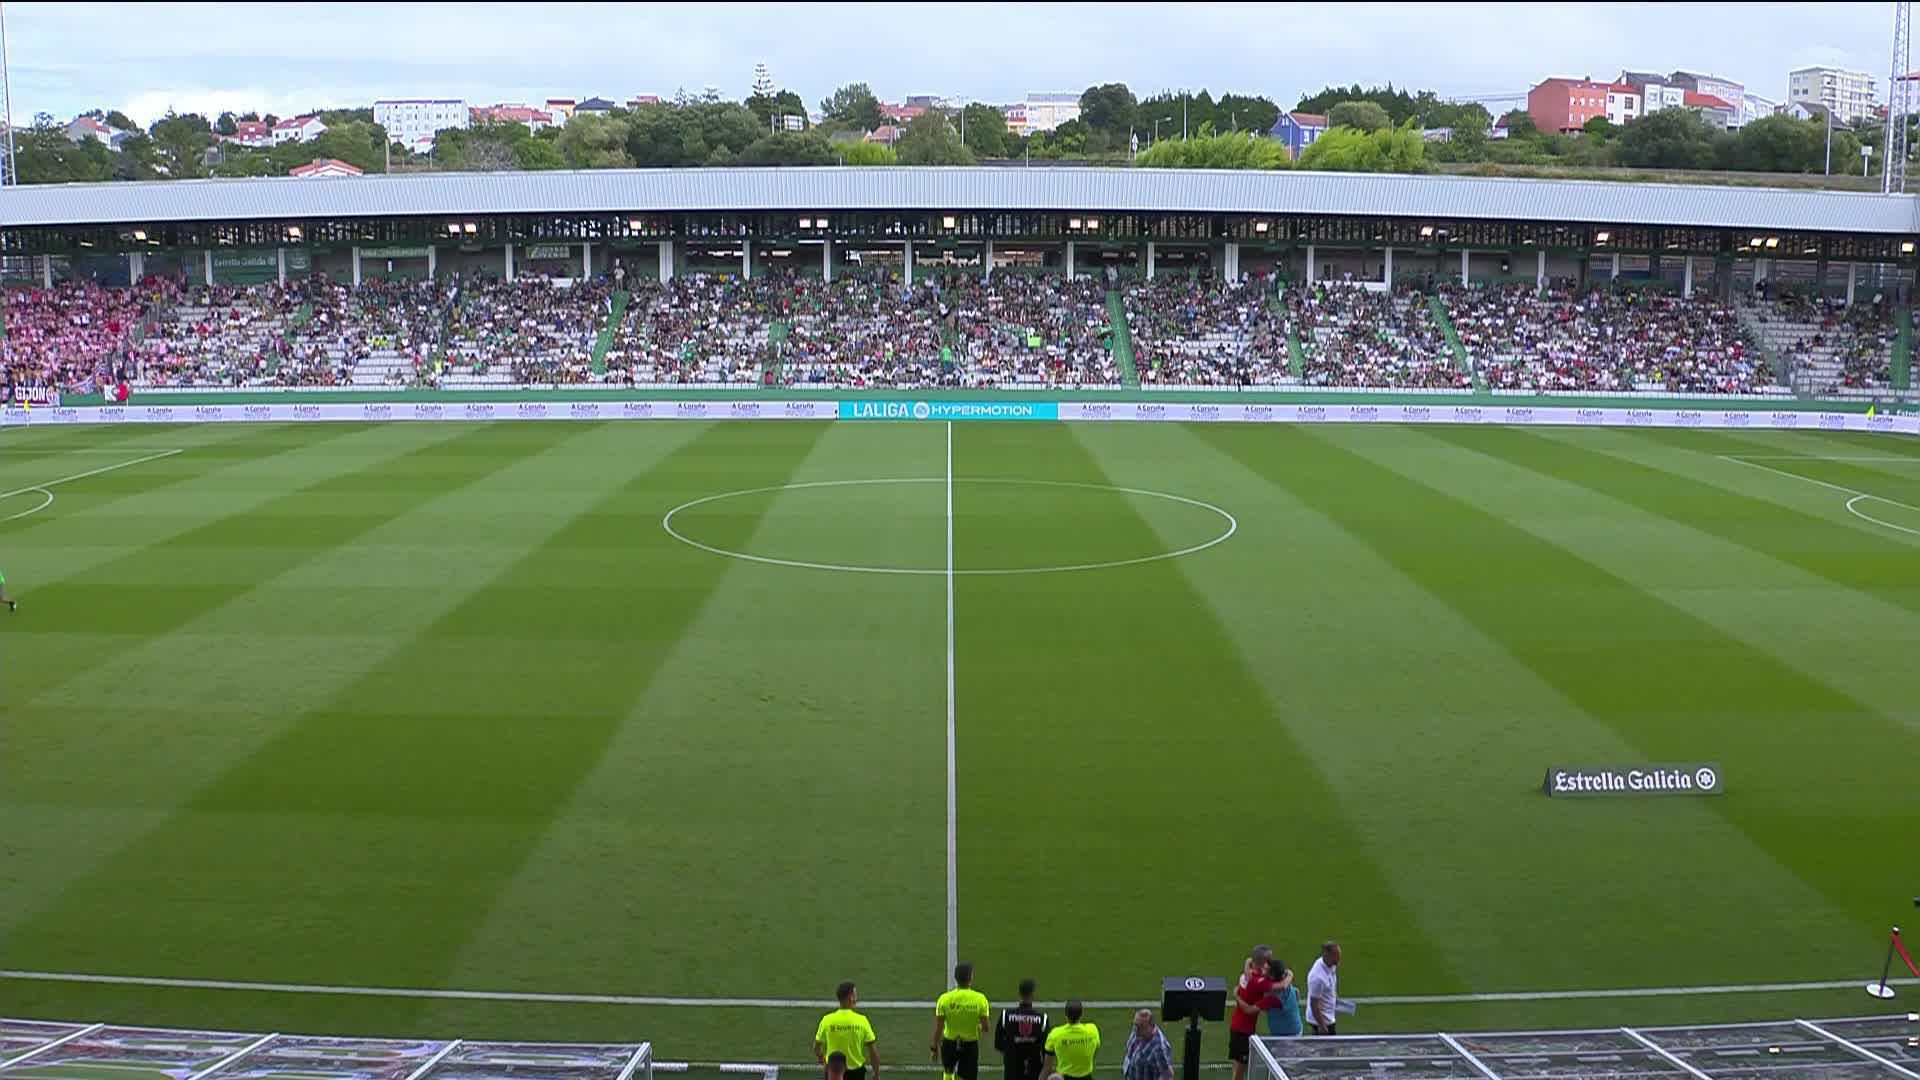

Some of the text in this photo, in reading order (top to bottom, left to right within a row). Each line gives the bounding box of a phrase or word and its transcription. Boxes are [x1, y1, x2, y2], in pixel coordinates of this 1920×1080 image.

[853, 402, 1033, 417] LALIGA HYPERMOTION
[1555, 770, 1692, 791] Estrella Galicia
